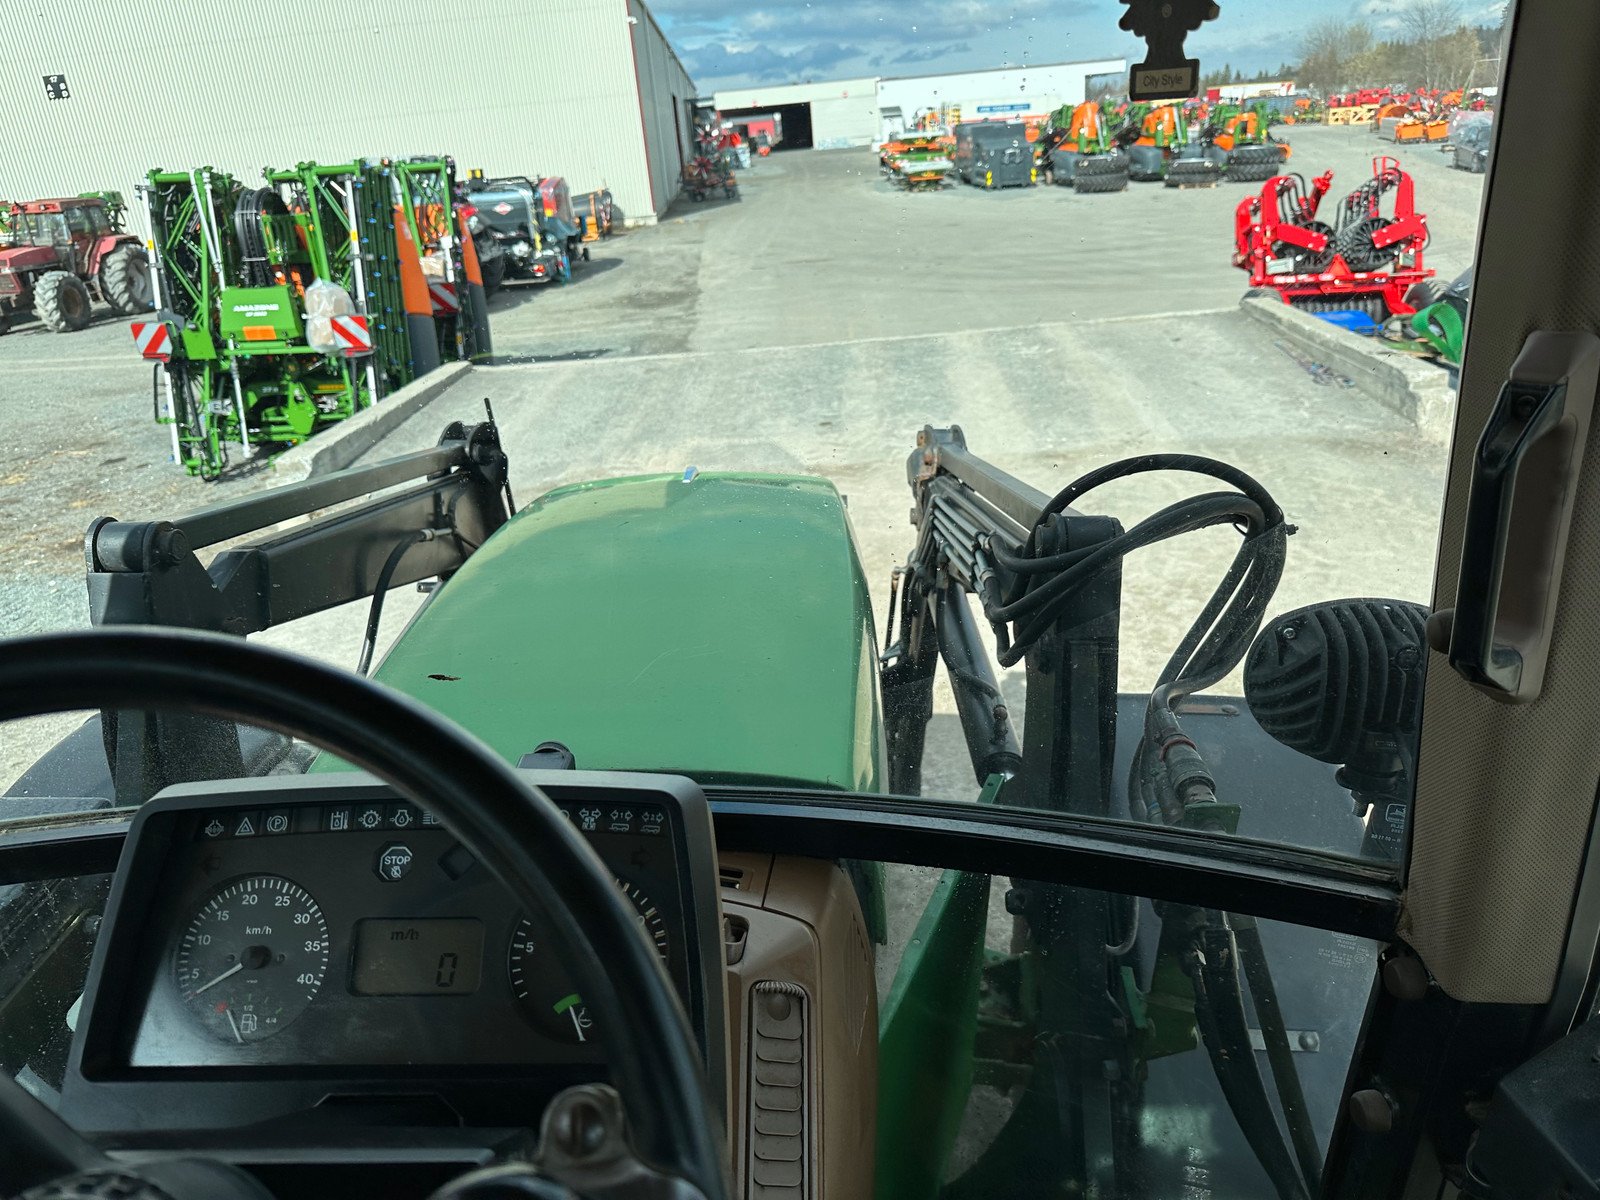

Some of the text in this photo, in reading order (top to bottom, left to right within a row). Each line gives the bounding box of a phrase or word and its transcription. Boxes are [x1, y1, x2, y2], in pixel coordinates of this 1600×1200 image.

[1143, 73, 1183, 89] City Style
[47, 83, 53, 91] A
[384, 855, 411, 865] STOP
[241, 894, 258, 905] 20
[275, 895, 291, 906] 25
[217, 910, 229, 921] 15
[293, 913, 310, 924] 30
[245, 926, 272, 935] km/h
[390, 928, 420, 940] m/h
[198, 934, 211, 945] 10
[304, 940, 321, 952] 35
[525, 941, 534, 953] 5
[191, 968, 200, 979] 5
[436, 952, 458, 988] 0
[296, 973, 314, 985] 40
[243, 1004, 254, 1012] 1/2
